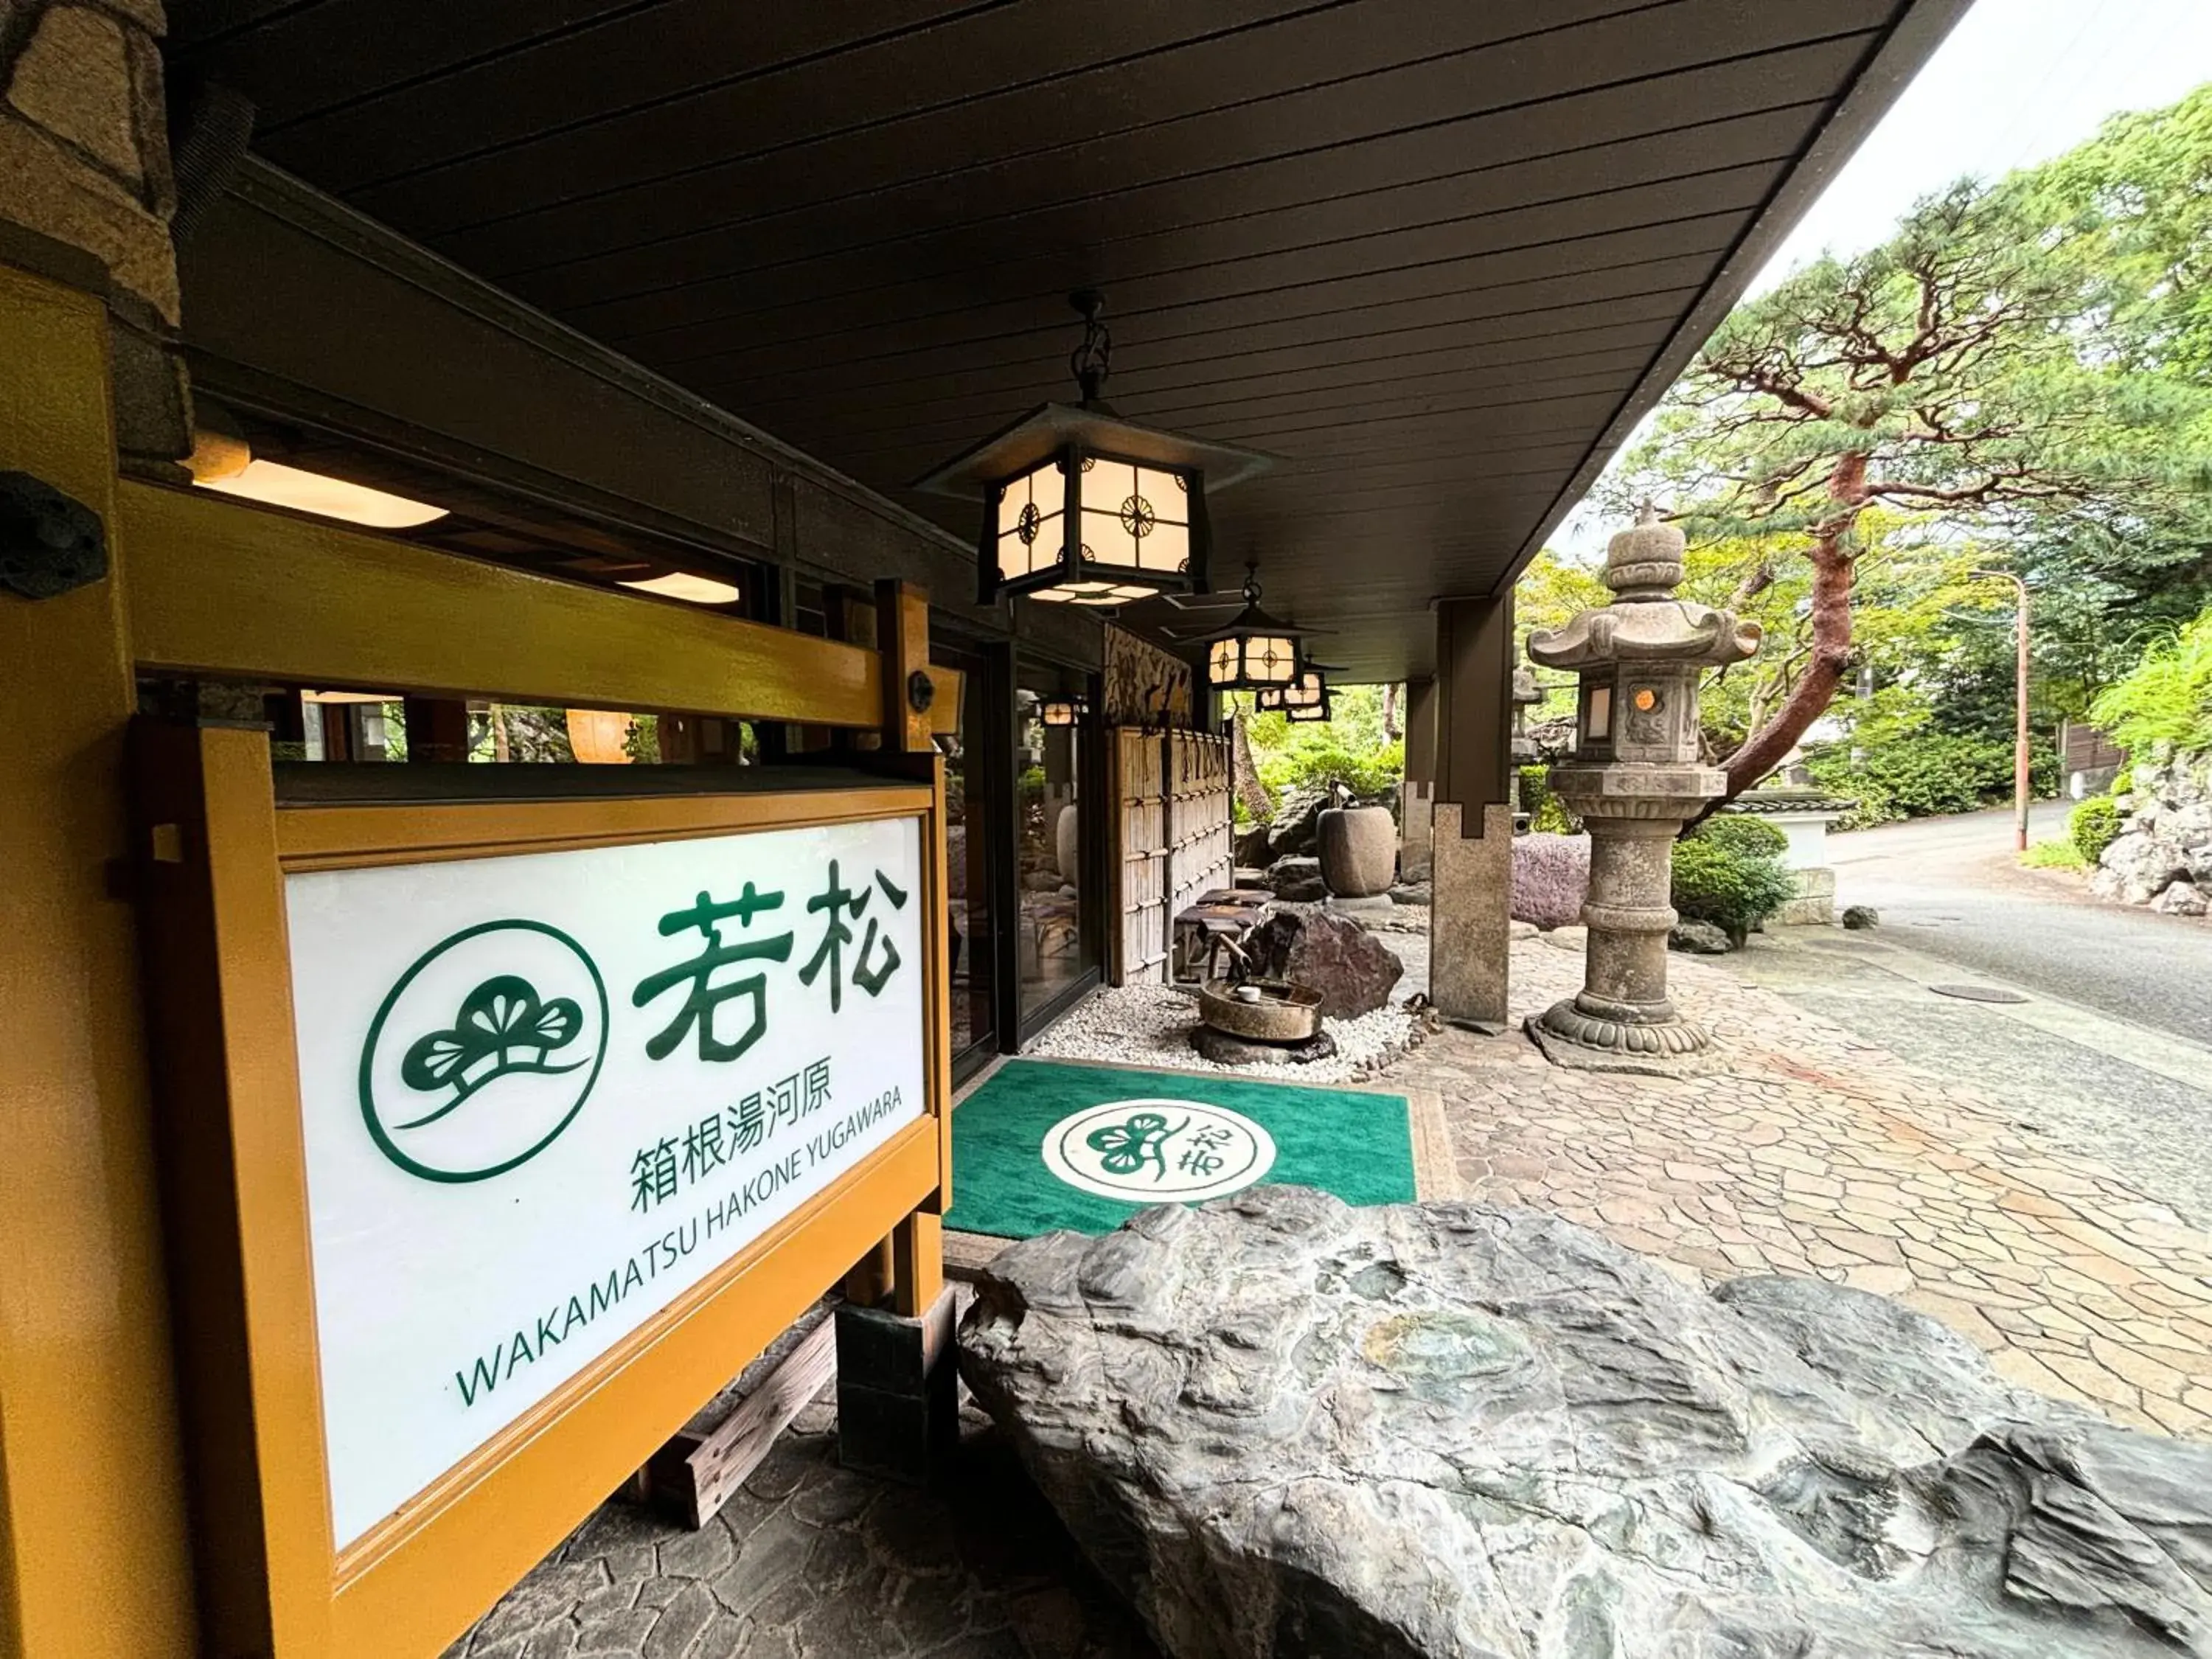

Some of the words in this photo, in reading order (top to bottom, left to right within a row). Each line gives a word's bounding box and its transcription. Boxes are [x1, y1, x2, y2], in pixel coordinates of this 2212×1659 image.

[632, 859, 908, 1062] 若松
[630, 1055, 832, 1214] 箱根湯河原
[1177, 1124, 1234, 1176] 若松
[455, 1218, 697, 1408] WAKAMATSU
[706, 1149, 801, 1239] HAKONE
[806, 1085, 902, 1167] YUGAWARA
